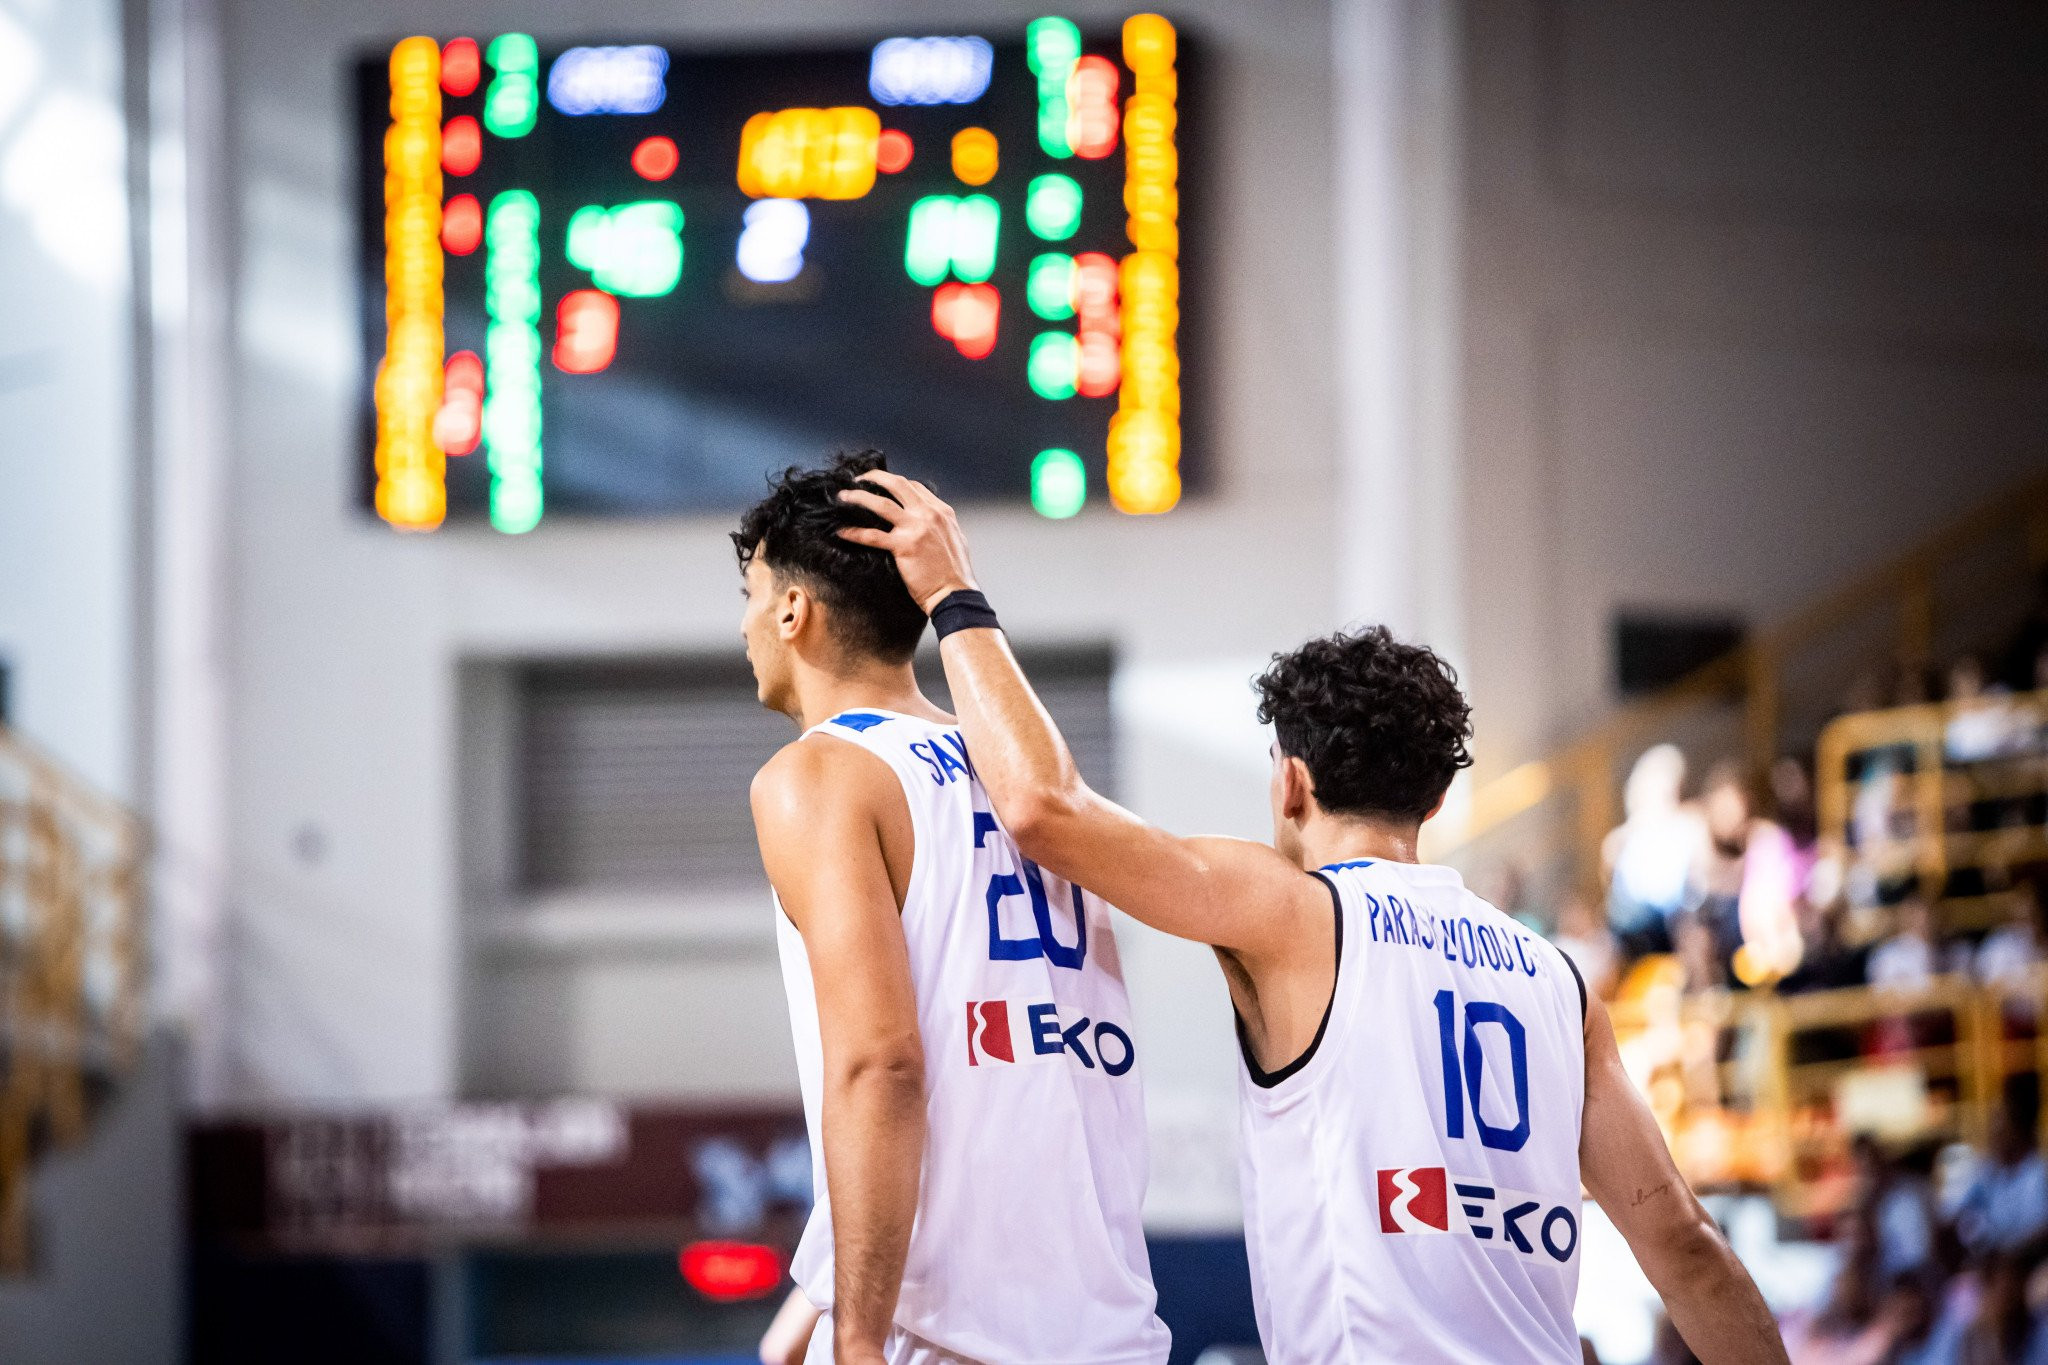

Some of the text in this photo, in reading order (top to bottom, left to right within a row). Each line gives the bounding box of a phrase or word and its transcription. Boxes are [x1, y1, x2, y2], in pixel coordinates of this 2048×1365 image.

[1027, 1003, 1135, 1077] EKO
[1433, 989, 1530, 1152] 10
[1453, 1183, 1578, 1263] EKO
